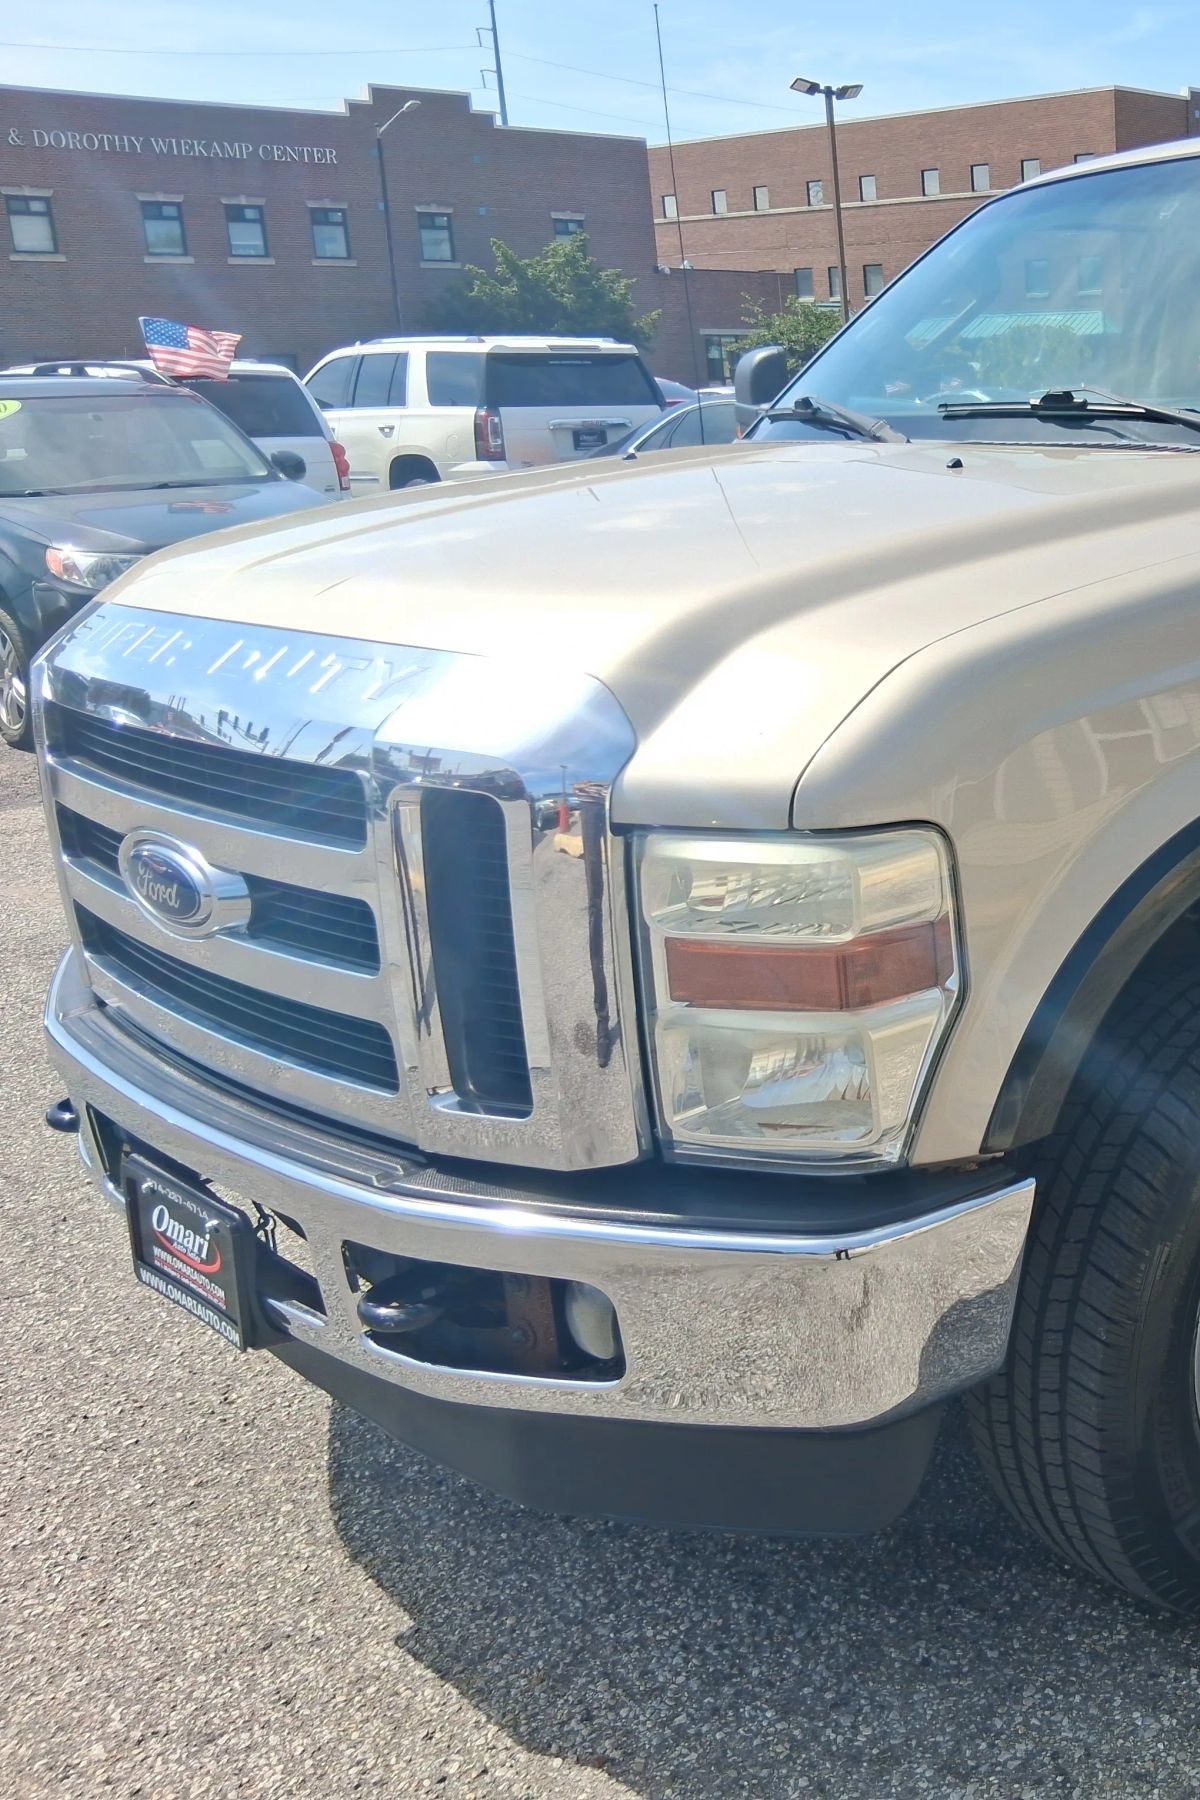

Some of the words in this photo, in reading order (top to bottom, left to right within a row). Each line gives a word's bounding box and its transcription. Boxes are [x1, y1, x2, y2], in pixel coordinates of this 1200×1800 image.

[8, 127, 25, 146] &
[32, 129, 144, 153] DOROTHY
[149, 136, 253, 159] WIEKAMP
[258, 144, 338, 164] CENTER
[136, 859, 181, 909] Ford
[152, 1204, 210, 1260] Omari
[139, 1266, 240, 1347] WWW.OMARIAUTO.COM
